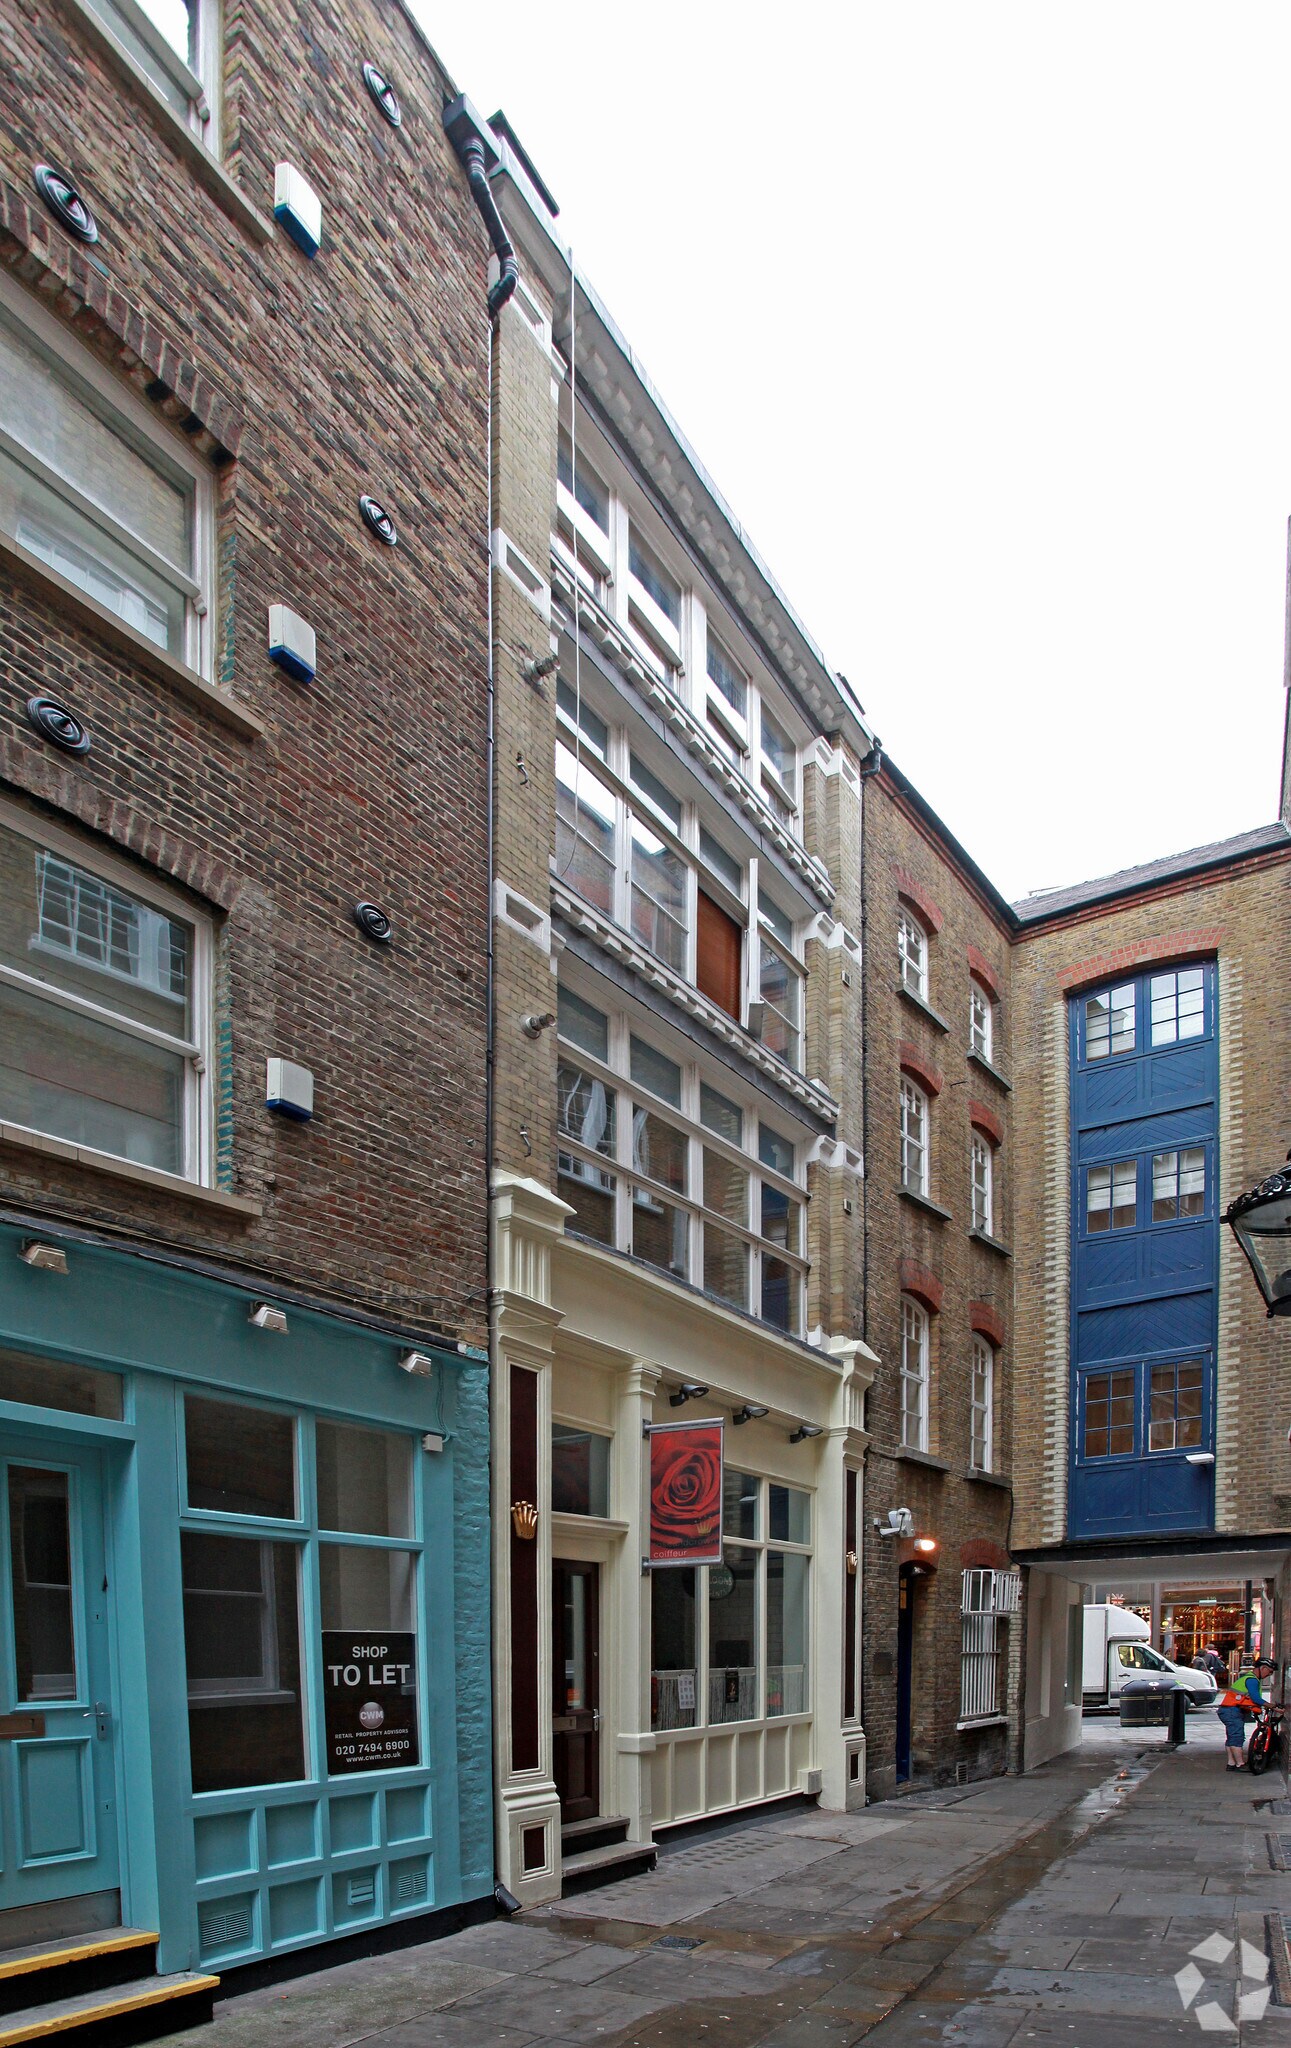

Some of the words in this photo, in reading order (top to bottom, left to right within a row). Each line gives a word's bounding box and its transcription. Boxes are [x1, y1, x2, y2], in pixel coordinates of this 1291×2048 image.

[653, 1549, 688, 1558] coiffeur
[352, 1646, 388, 1658] SHOP
[327, 1664, 361, 1687] TO
[368, 1663, 411, 1686] LET
[360, 1710, 384, 1720] CWM
[335, 1745, 355, 1756] 020
[358, 1742, 383, 1753] 7494
[385, 1740, 410, 1751] 6900
[346, 1752, 401, 1762] www.cwm.co.uk
